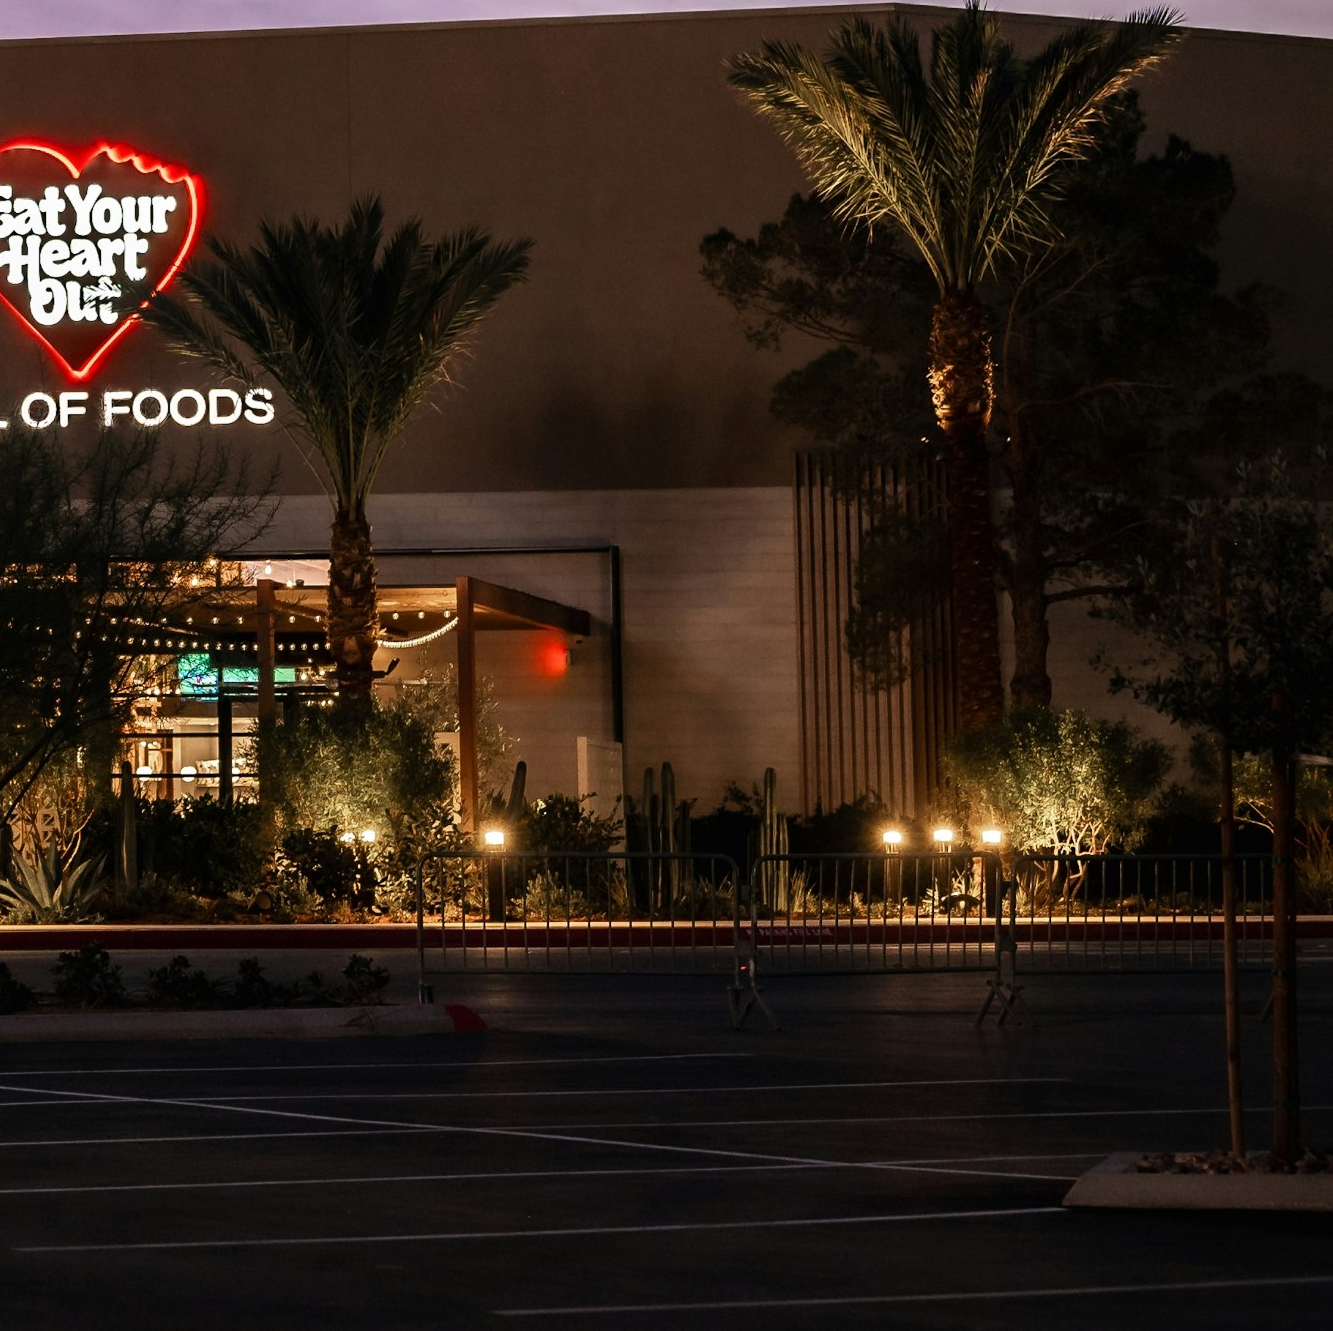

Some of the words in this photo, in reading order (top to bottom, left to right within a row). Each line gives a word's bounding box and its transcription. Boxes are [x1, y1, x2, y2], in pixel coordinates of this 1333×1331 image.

[64, 184, 177, 235] Your
[29, 275, 122, 326] Out
[21, 391, 89, 429] OF
[102, 388, 275, 428] FOODS
